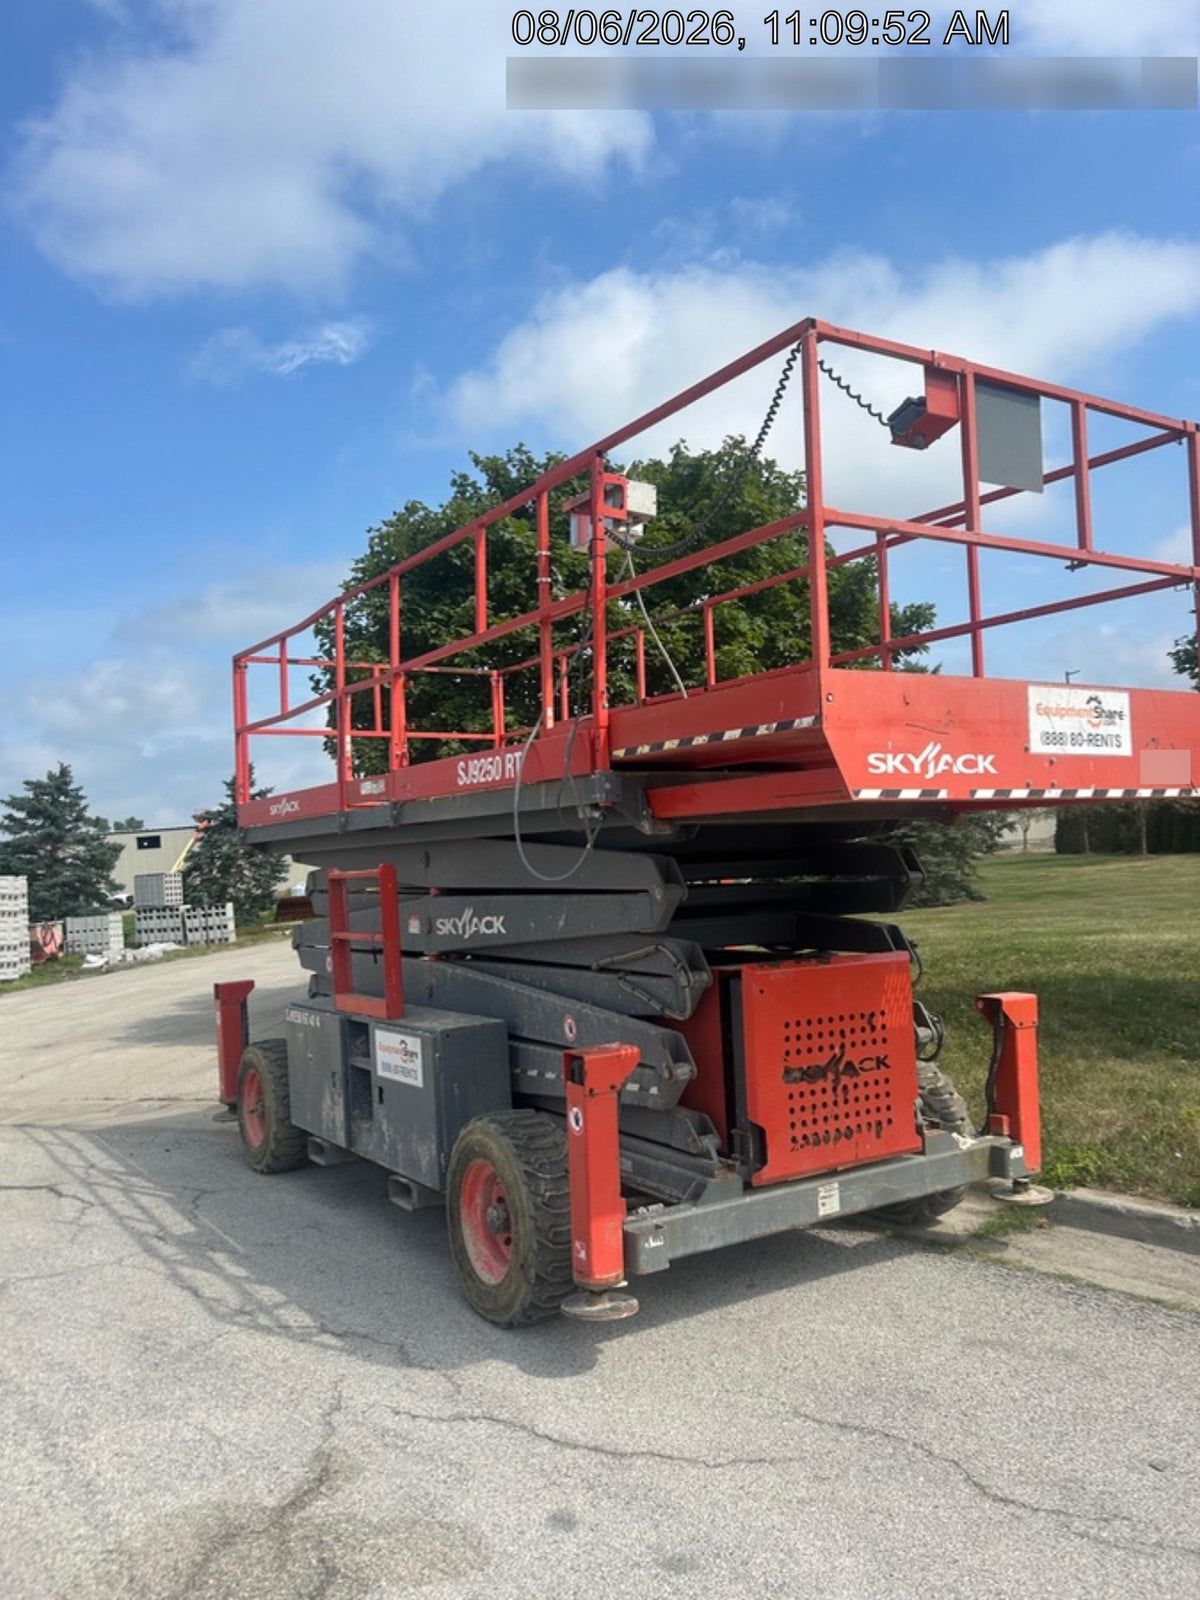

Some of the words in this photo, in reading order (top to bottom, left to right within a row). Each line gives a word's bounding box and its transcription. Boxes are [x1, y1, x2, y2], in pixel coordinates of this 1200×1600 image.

[457, 755, 502, 786] SJ9250
[505, 751, 522, 779] RT
[867, 741, 998, 779] SKYJACK
[436, 907, 506, 939] SKYJACK
